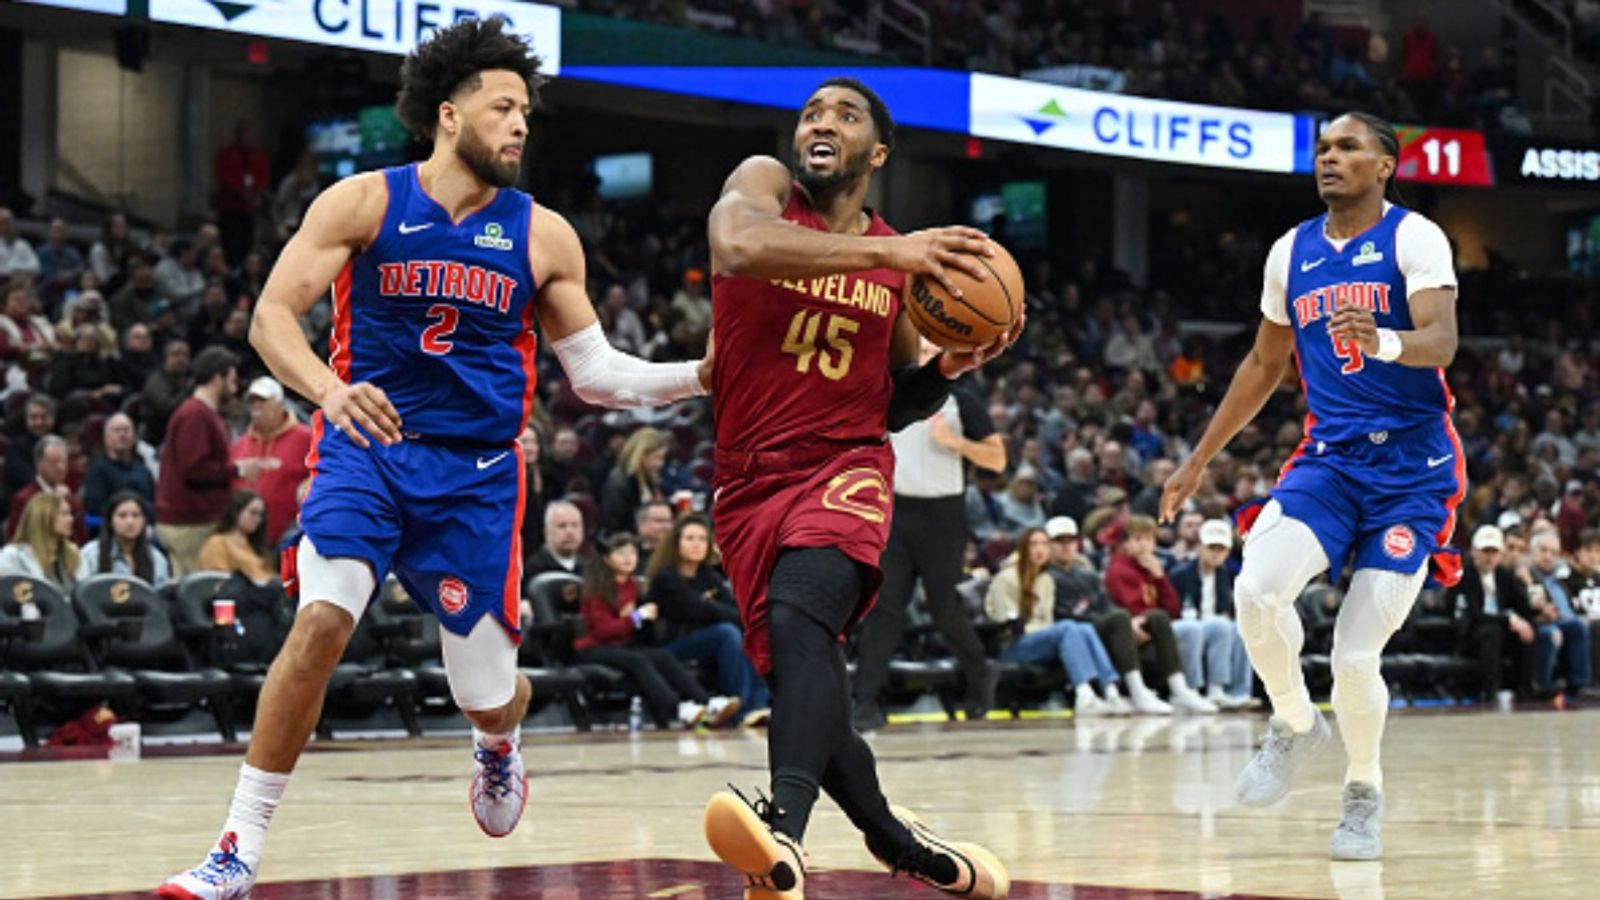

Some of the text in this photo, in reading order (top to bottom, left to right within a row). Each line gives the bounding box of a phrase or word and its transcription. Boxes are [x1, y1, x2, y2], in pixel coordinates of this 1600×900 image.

[312, 0, 515, 43] CLIF
[1093, 106, 1253, 159] CLIFFS
[1422, 138, 1460, 177] 11
[377, 260, 518, 314] DETROIT
[1293, 282, 1391, 328] DETROIT
[420, 303, 459, 356] 2
[781, 308, 860, 381] 45
